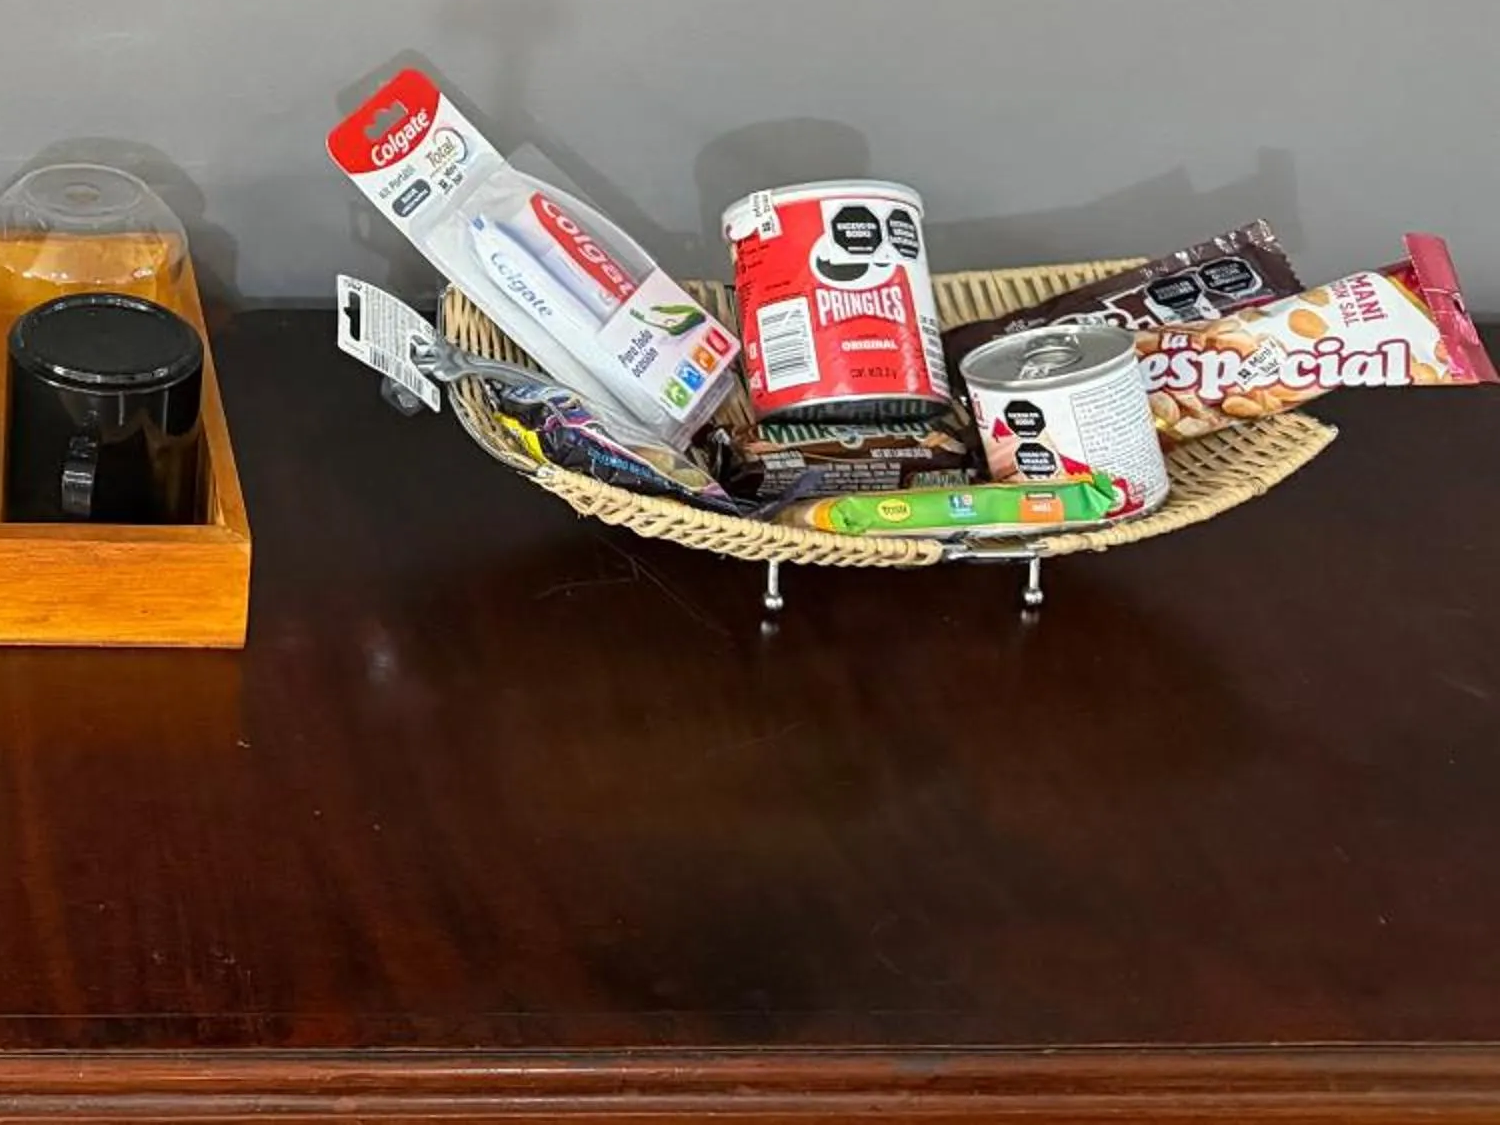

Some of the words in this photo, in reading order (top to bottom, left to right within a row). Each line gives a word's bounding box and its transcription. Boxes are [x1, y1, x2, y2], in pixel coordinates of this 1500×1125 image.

[371, 110, 430, 166] Colgate
[426, 135, 455, 168] Total
[540, 198, 637, 296] Colgat
[491, 252, 553, 317] Colgate
[1353, 273, 1389, 324] MANÍ
[815, 286, 907, 326] PRINGLES
[1338, 301, 1363, 328] SAL
[841, 338, 899, 352] ORIGINAL
[1161, 332, 1189, 349] la
